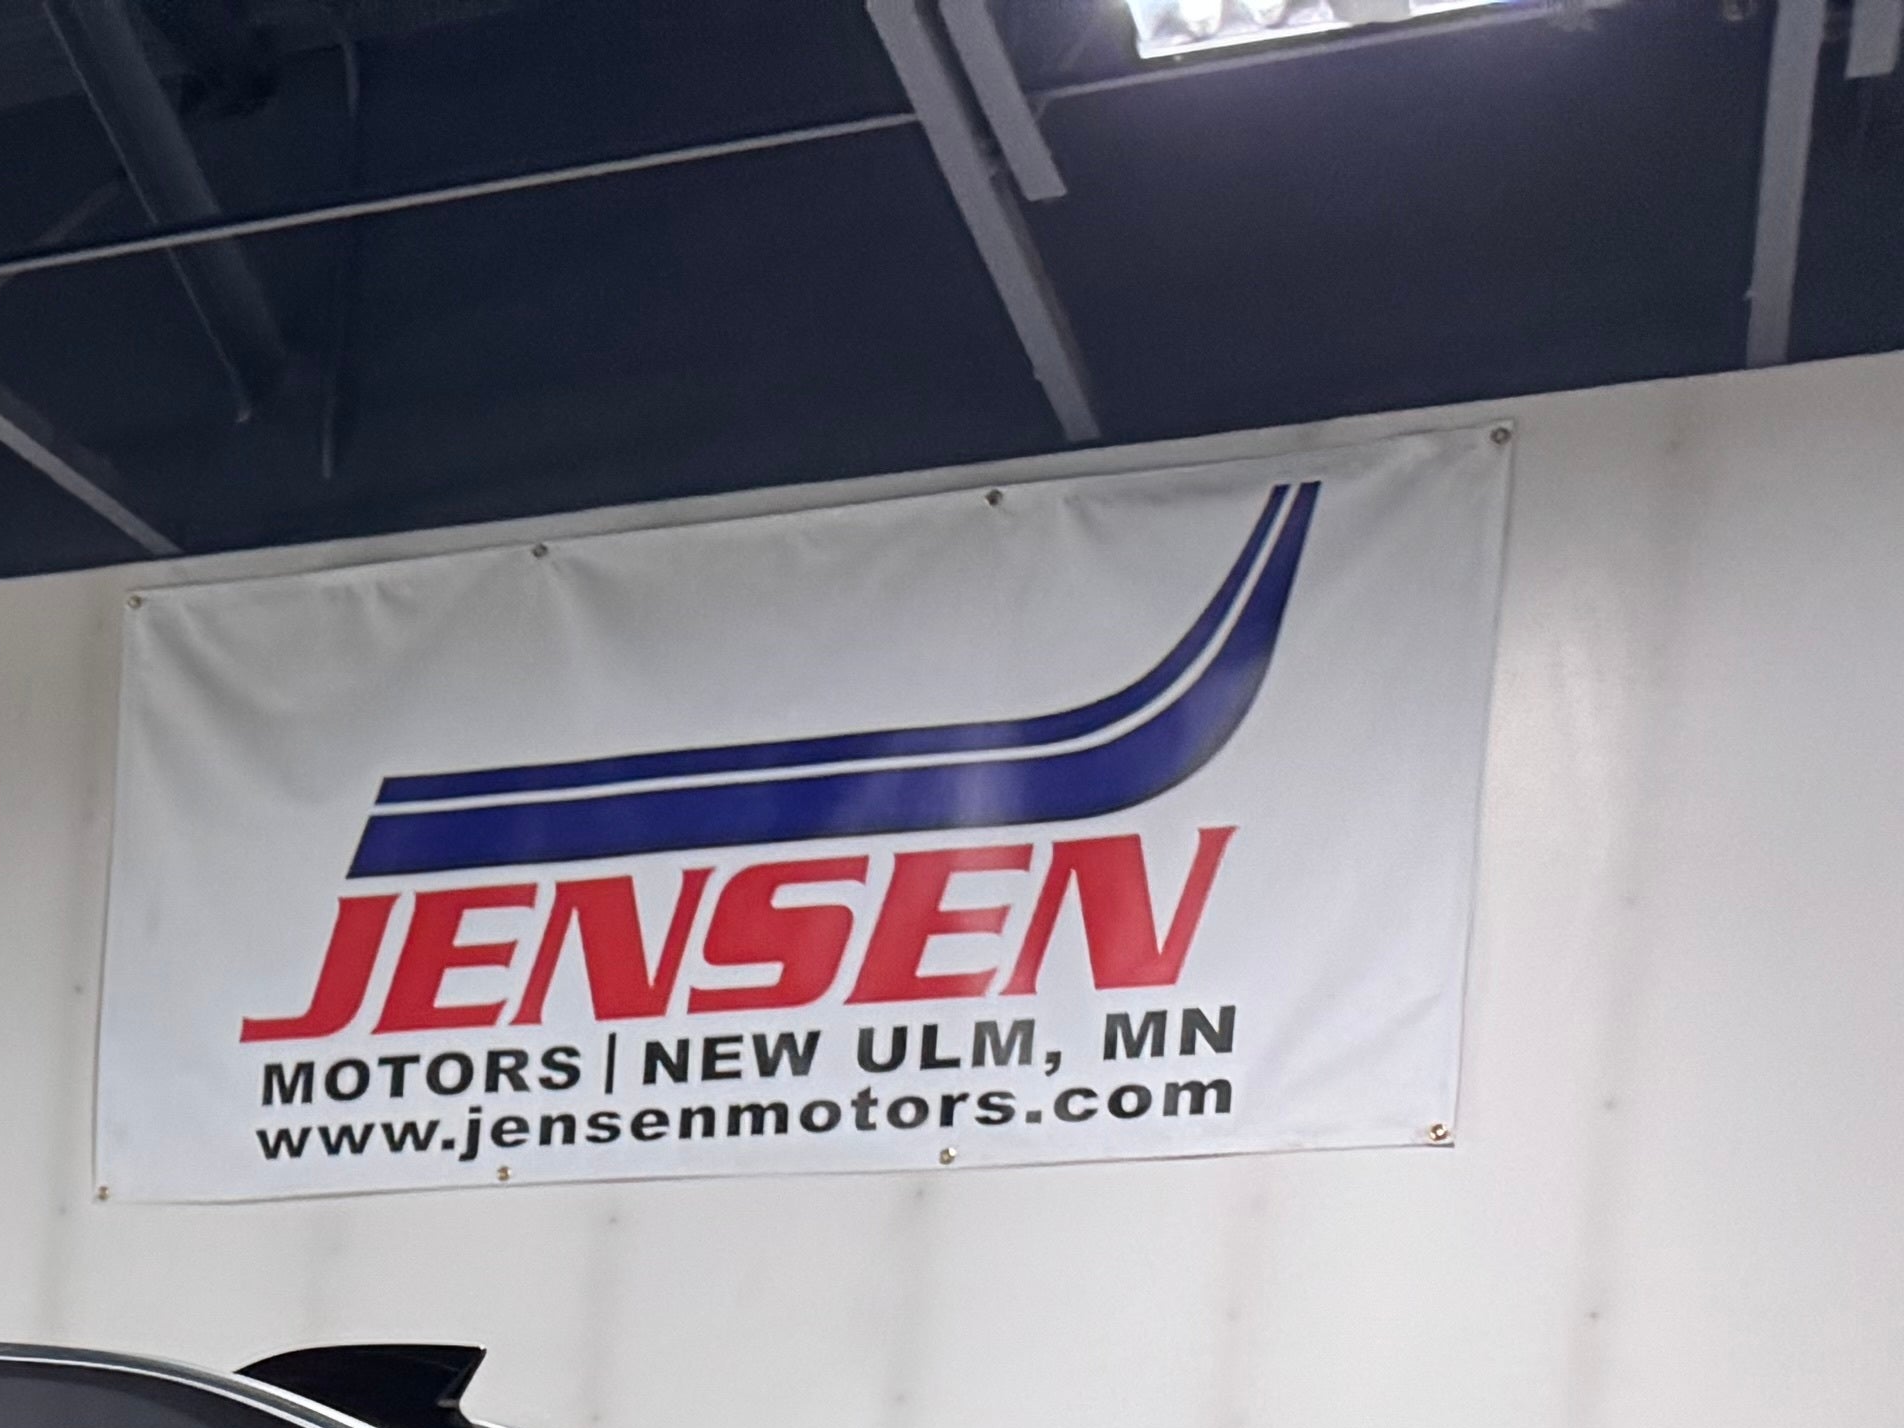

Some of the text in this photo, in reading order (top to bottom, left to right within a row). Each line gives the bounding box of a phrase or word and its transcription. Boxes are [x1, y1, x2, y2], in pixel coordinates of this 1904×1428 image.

[240, 826, 1235, 1044] JENSEN
[262, 1045, 582, 1107] MOTORS
[642, 1029, 822, 1086] NEW
[856, 1018, 1063, 1078] ULM,
[1103, 1005, 1237, 1061] MN
[255, 1079, 1233, 1163] www.jensenmotors.com
